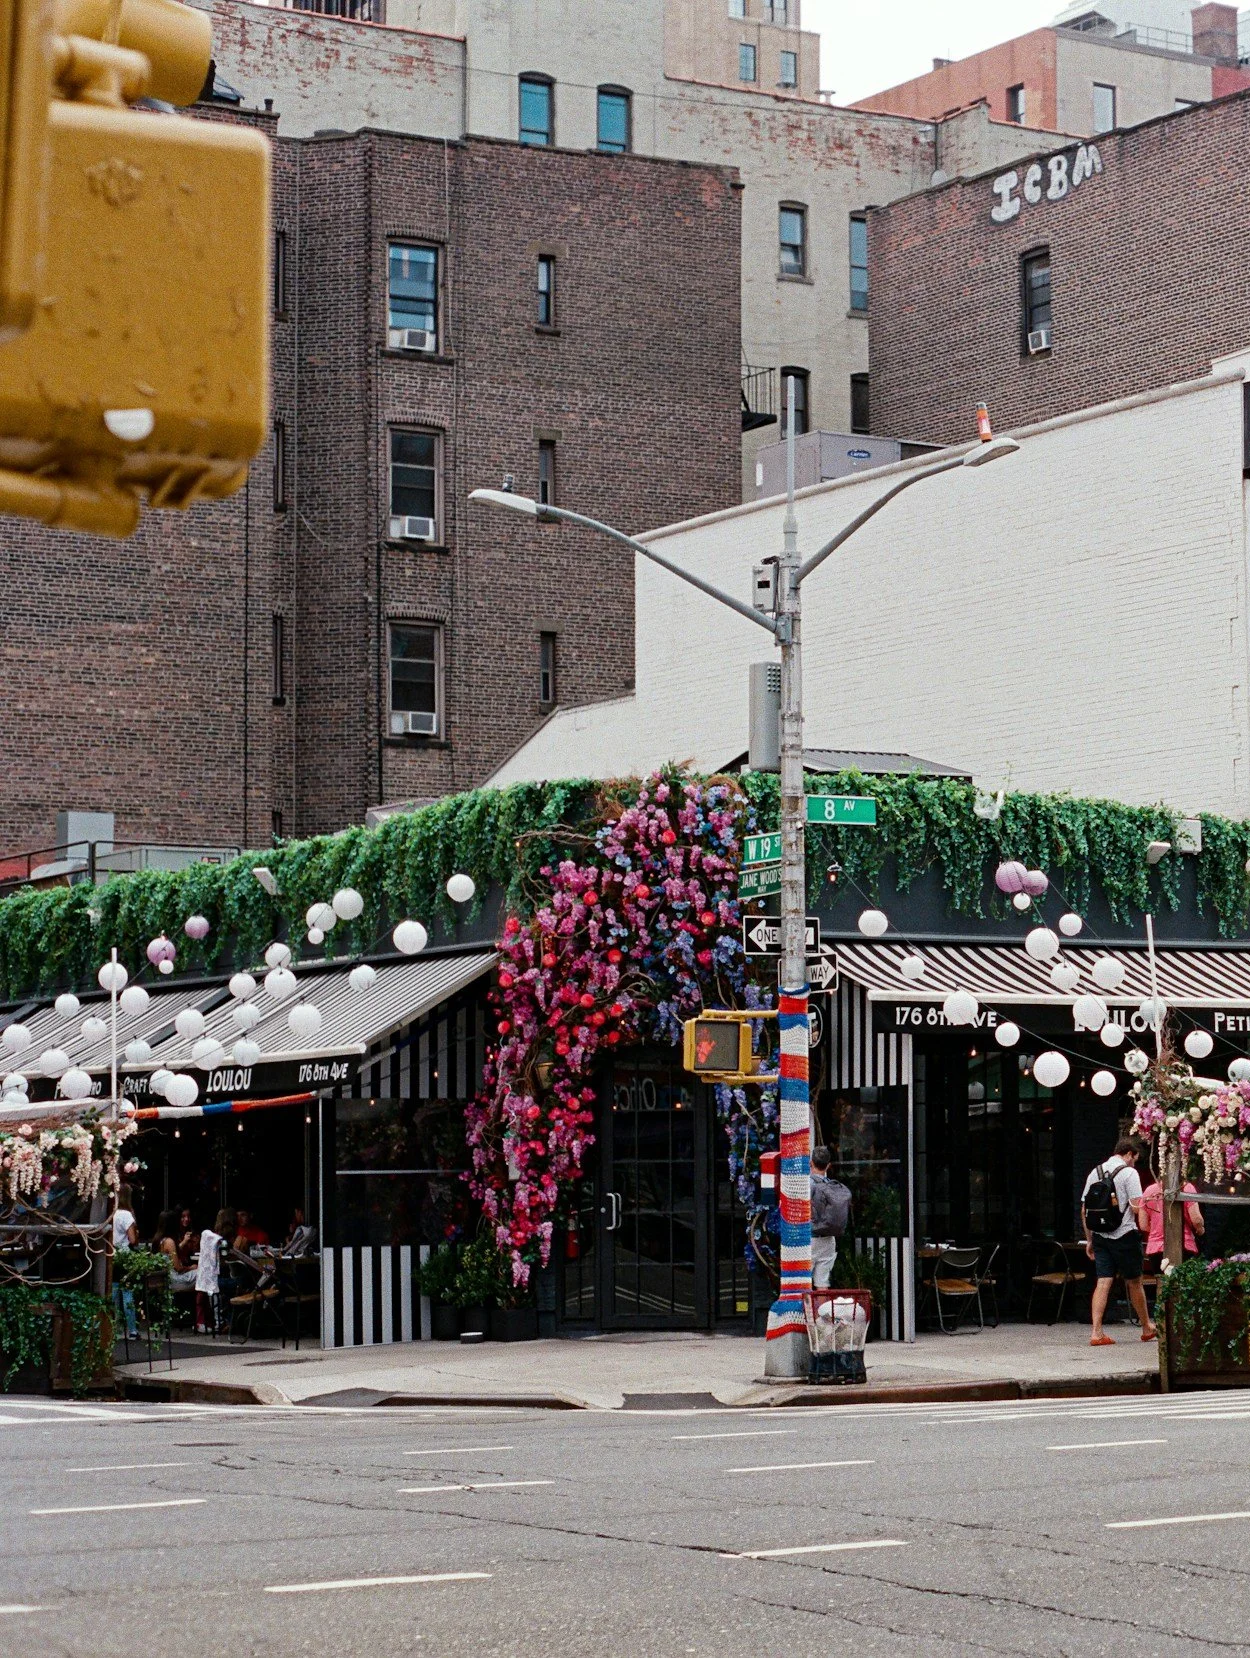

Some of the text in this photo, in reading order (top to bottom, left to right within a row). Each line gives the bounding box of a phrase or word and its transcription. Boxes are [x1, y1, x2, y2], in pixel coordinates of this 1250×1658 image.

[824, 800, 855, 820] 8 AV
[748, 840, 757, 860] W
[761, 837, 771, 859] 19
[741, 872, 758, 889] JANE
[756, 928, 778, 943] ONE
[810, 966, 830, 980] WAY
[895, 1006, 998, 1029] 176 8T VE
[205, 1068, 252, 1093] LOULOU
[298, 1061, 349, 1083] 176 8TH AVE
